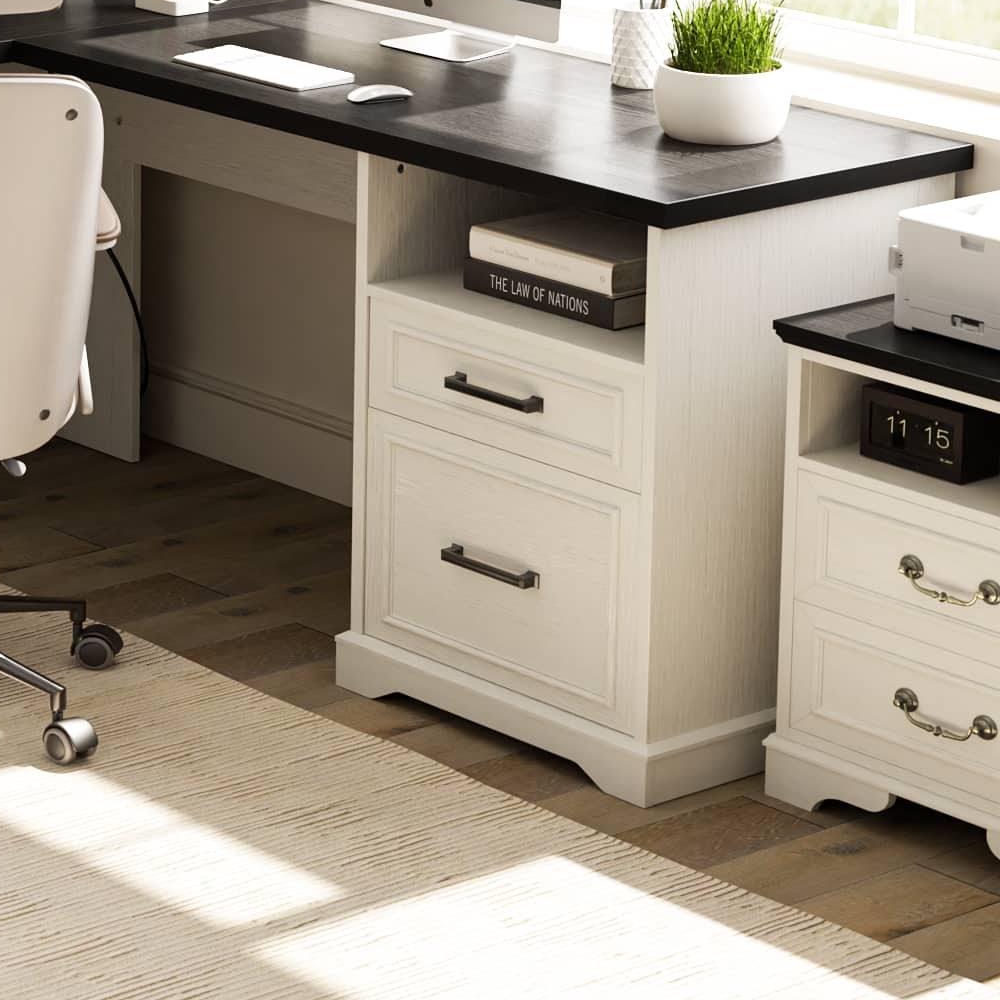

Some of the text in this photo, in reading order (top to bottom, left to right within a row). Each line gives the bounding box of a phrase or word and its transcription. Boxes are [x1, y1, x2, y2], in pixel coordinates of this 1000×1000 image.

[489, 273, 589, 316] THE LAW OF NATIONS
[887, 415, 950, 449] 11 15
